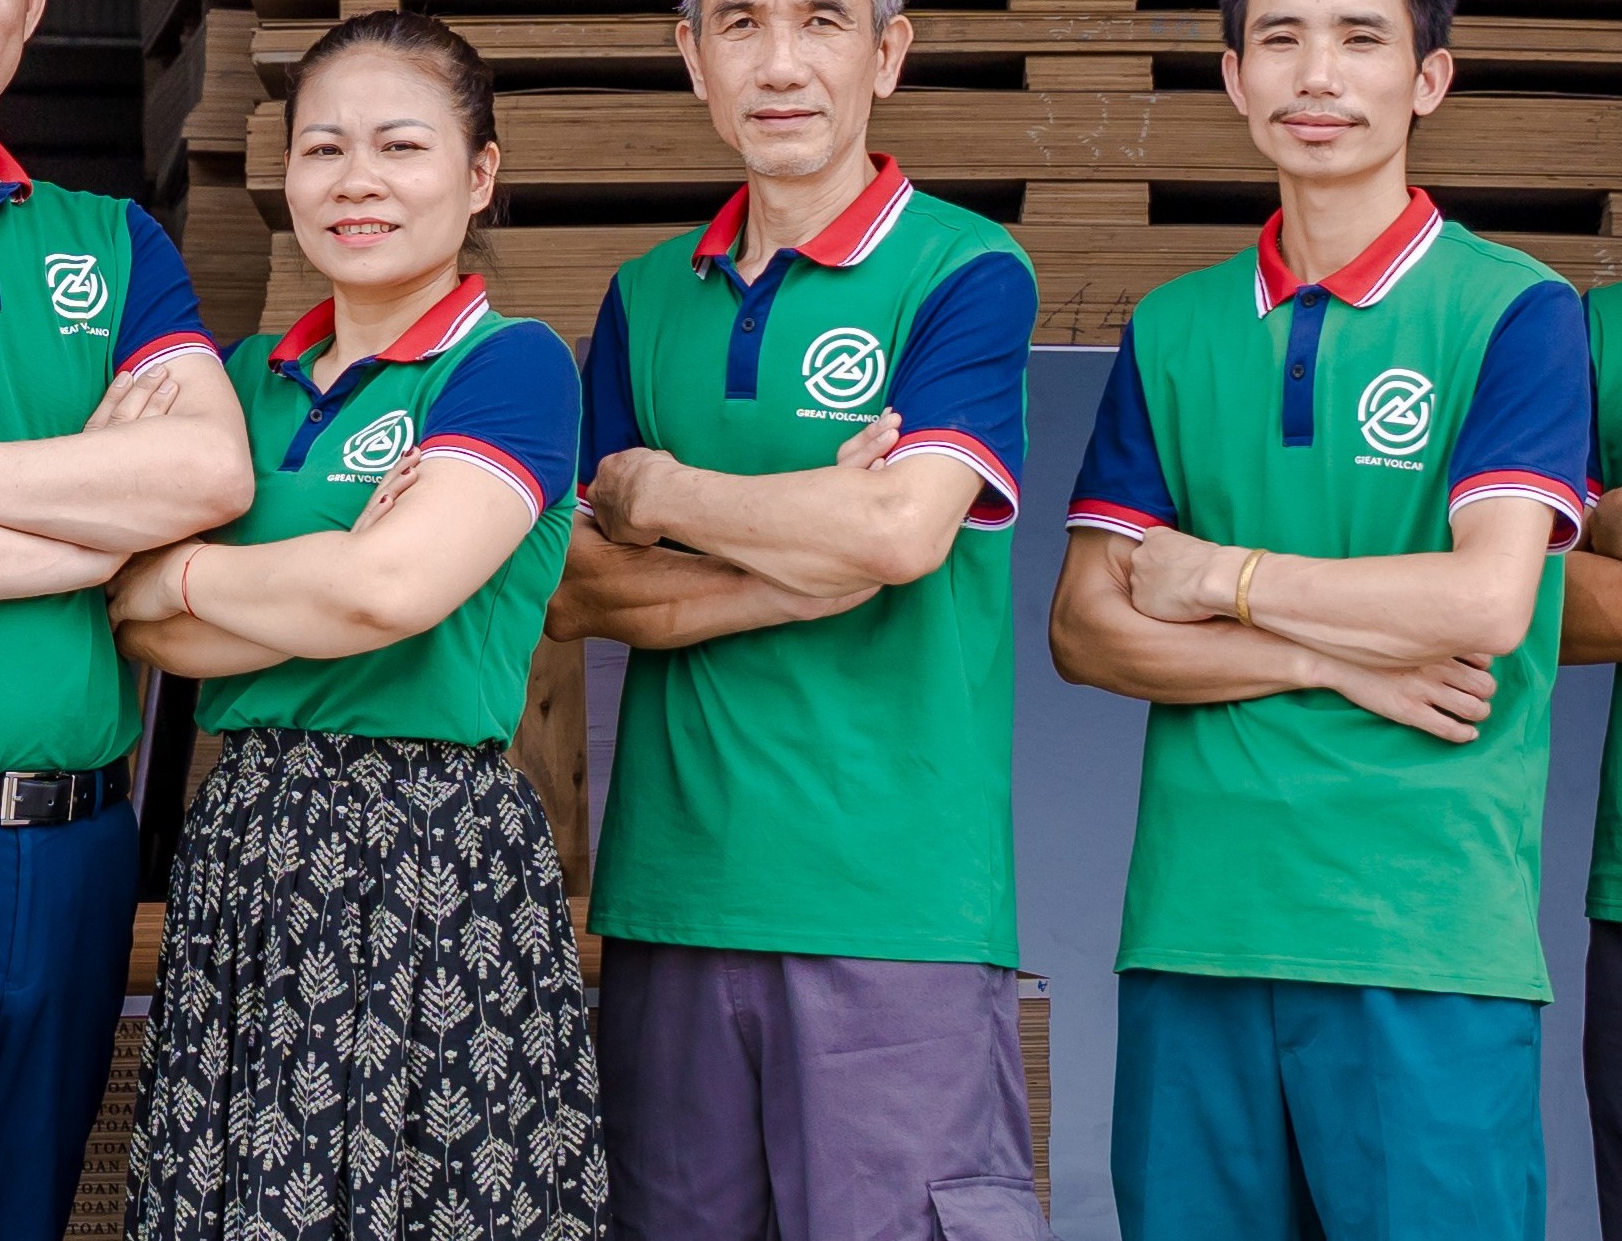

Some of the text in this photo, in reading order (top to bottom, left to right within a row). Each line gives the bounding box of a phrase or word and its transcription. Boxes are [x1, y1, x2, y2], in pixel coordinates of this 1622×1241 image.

[796, 409, 880, 423] GREAT VOLCANO
[327, 474, 356, 483] GREAT
